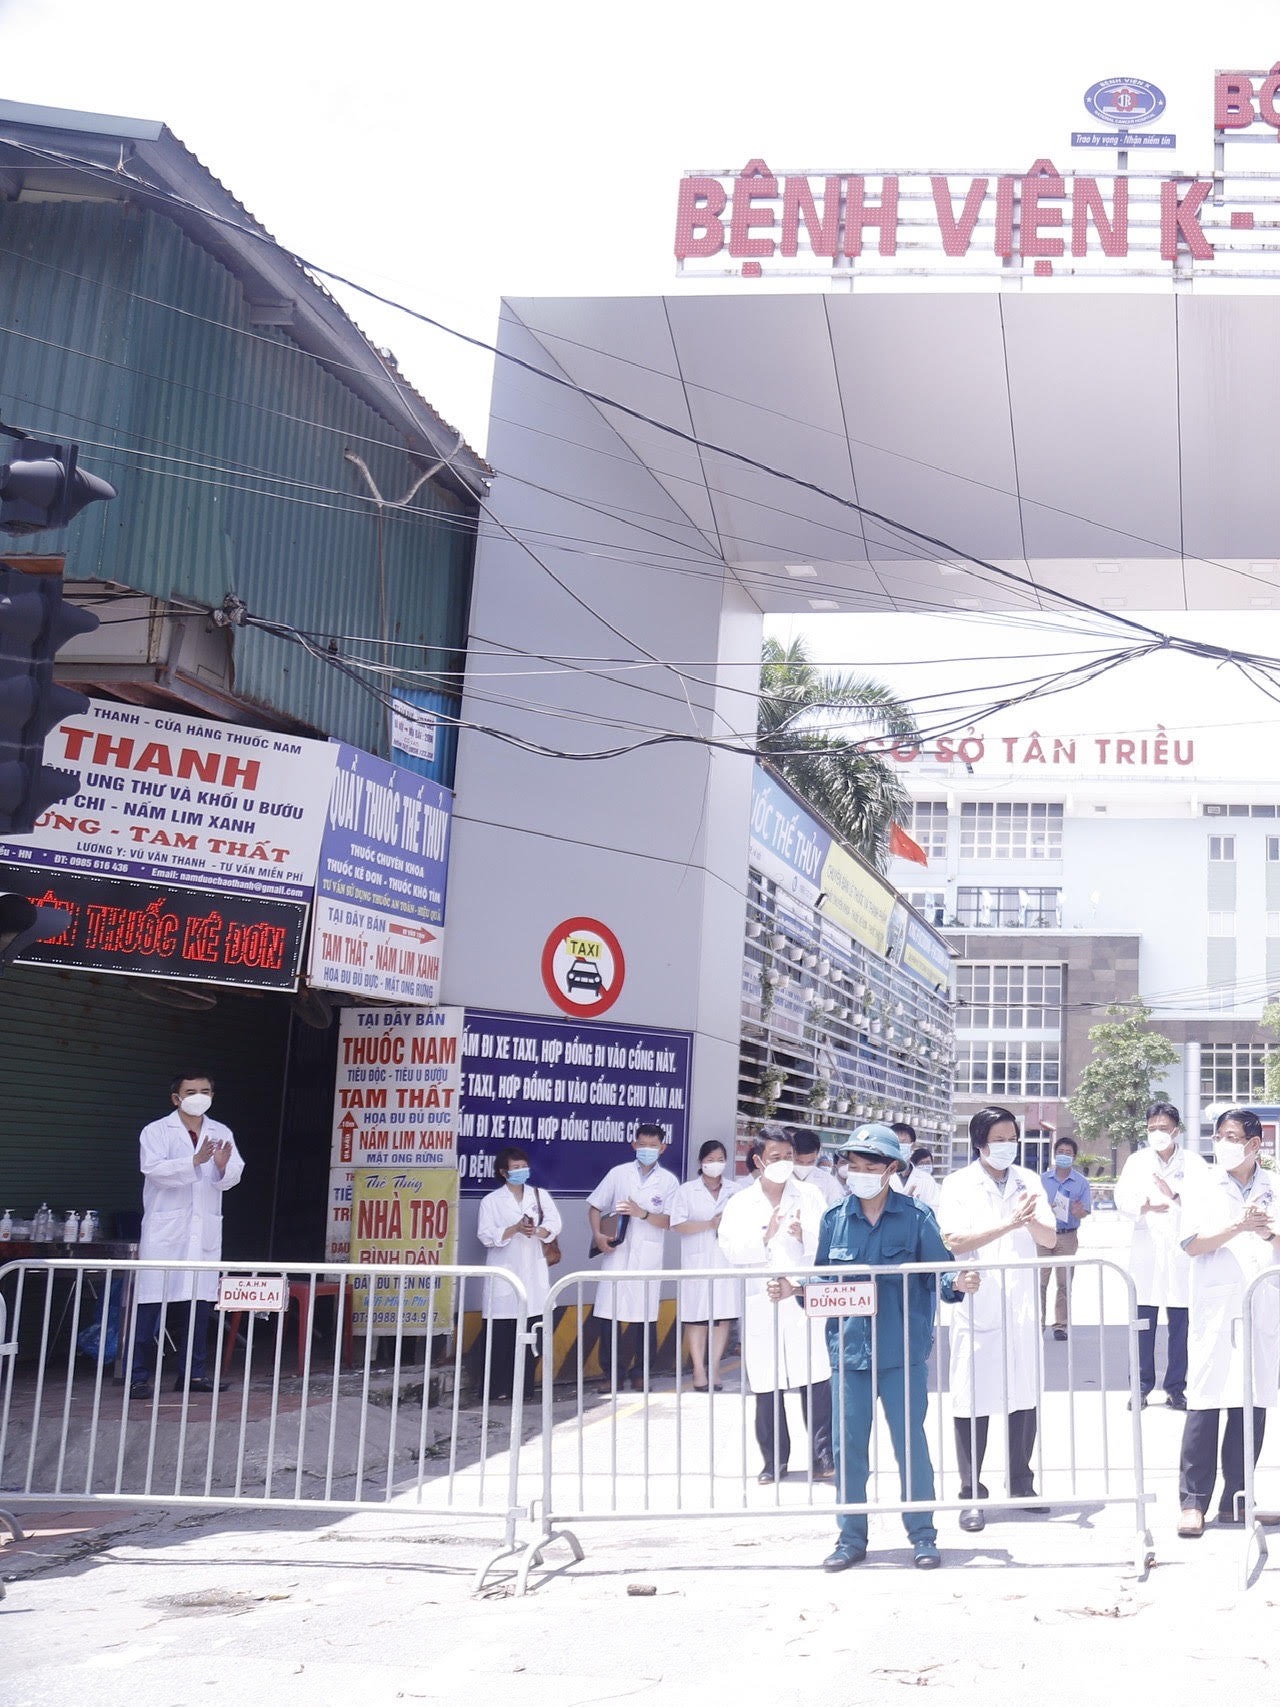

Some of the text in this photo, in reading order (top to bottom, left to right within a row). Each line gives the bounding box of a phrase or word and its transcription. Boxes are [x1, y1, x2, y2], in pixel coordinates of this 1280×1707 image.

[674, 158, 899, 278] BỆNH
[930, 159, 1128, 277] VIỆN
[1160, 181, 1214, 261] K
[94, 707, 302, 755] THANH HÀNG THUỐC NAM
[1002, 731, 1076, 764] TÂN
[1095, 723, 1195, 765] TRIỀU
[60, 726, 261, 791] THANH
[74, 795, 105, 811] CHI
[123, 800, 166, 820] NẤM
[171, 809, 203, 826] LIM
[207, 816, 256, 834] XANH
[86, 772, 304, 820] UNG THƯ VÀ U BƯỚU
[400, 784, 425, 854] THẾ
[77, 841, 113, 856] LƯƠNG
[117, 846, 126, 857] Y:
[172, 854, 206, 868] THANH
[286, 871, 303, 882] PHÍ
[129, 826, 290, 863] TAM THẤT
[18, 849, 33, 860] HN
[69, 856, 91, 867] 0985
[93, 861, 110, 870] 616
[111, 863, 128, 873] 436
[151, 867, 179, 880] Email:
[376, 852, 425, 879] CHUYÊN KHOA
[86, 897, 179, 957] THUỐC
[182, 911, 222, 963] KÊ
[224, 921, 287, 970] ĐƠN
[328, 907, 343, 926] TẠI
[322, 930, 368, 968] TAM THẤT
[570, 940, 600, 957] TAXI
[400, 980, 415, 996] ONG
[358, 1010, 445, 1029] TẠI ĐÂY BÁN
[342, 1027, 457, 1065] THUỐC NAM
[496, 1035, 654, 1072] XE TAXI, HỢP ĐỒNG VÀO CỔNG
[416, 1069, 422, 1082] U
[468, 1070, 647, 1107] TAXI, HỢP ĐỒNG VÀO CỔNG CHU
[339, 1082, 455, 1109] TAM THẤT
[359, 1123, 389, 1150] NẤM
[392, 1131, 418, 1150] LIM
[419, 1131, 453, 1150] XANH
[389, 1112, 406, 1124] ĐU
[490, 1115, 506, 1139] XE
[508, 1116, 535, 1142] TAXI,
[537, 1116, 559, 1145] HỢP
[561, 1112, 589, 1142] ĐỒNG
[590, 1116, 625, 1142] KHÔNG
[366, 1152, 389, 1165] MẬT
[391, 1153, 412, 1164] ONG
[357, 1191, 449, 1248] NHÀ TRỌ
[224, 1287, 279, 1303] DỪNG LẠI
[810, 1294, 871, 1308] DỪNG LẠI
